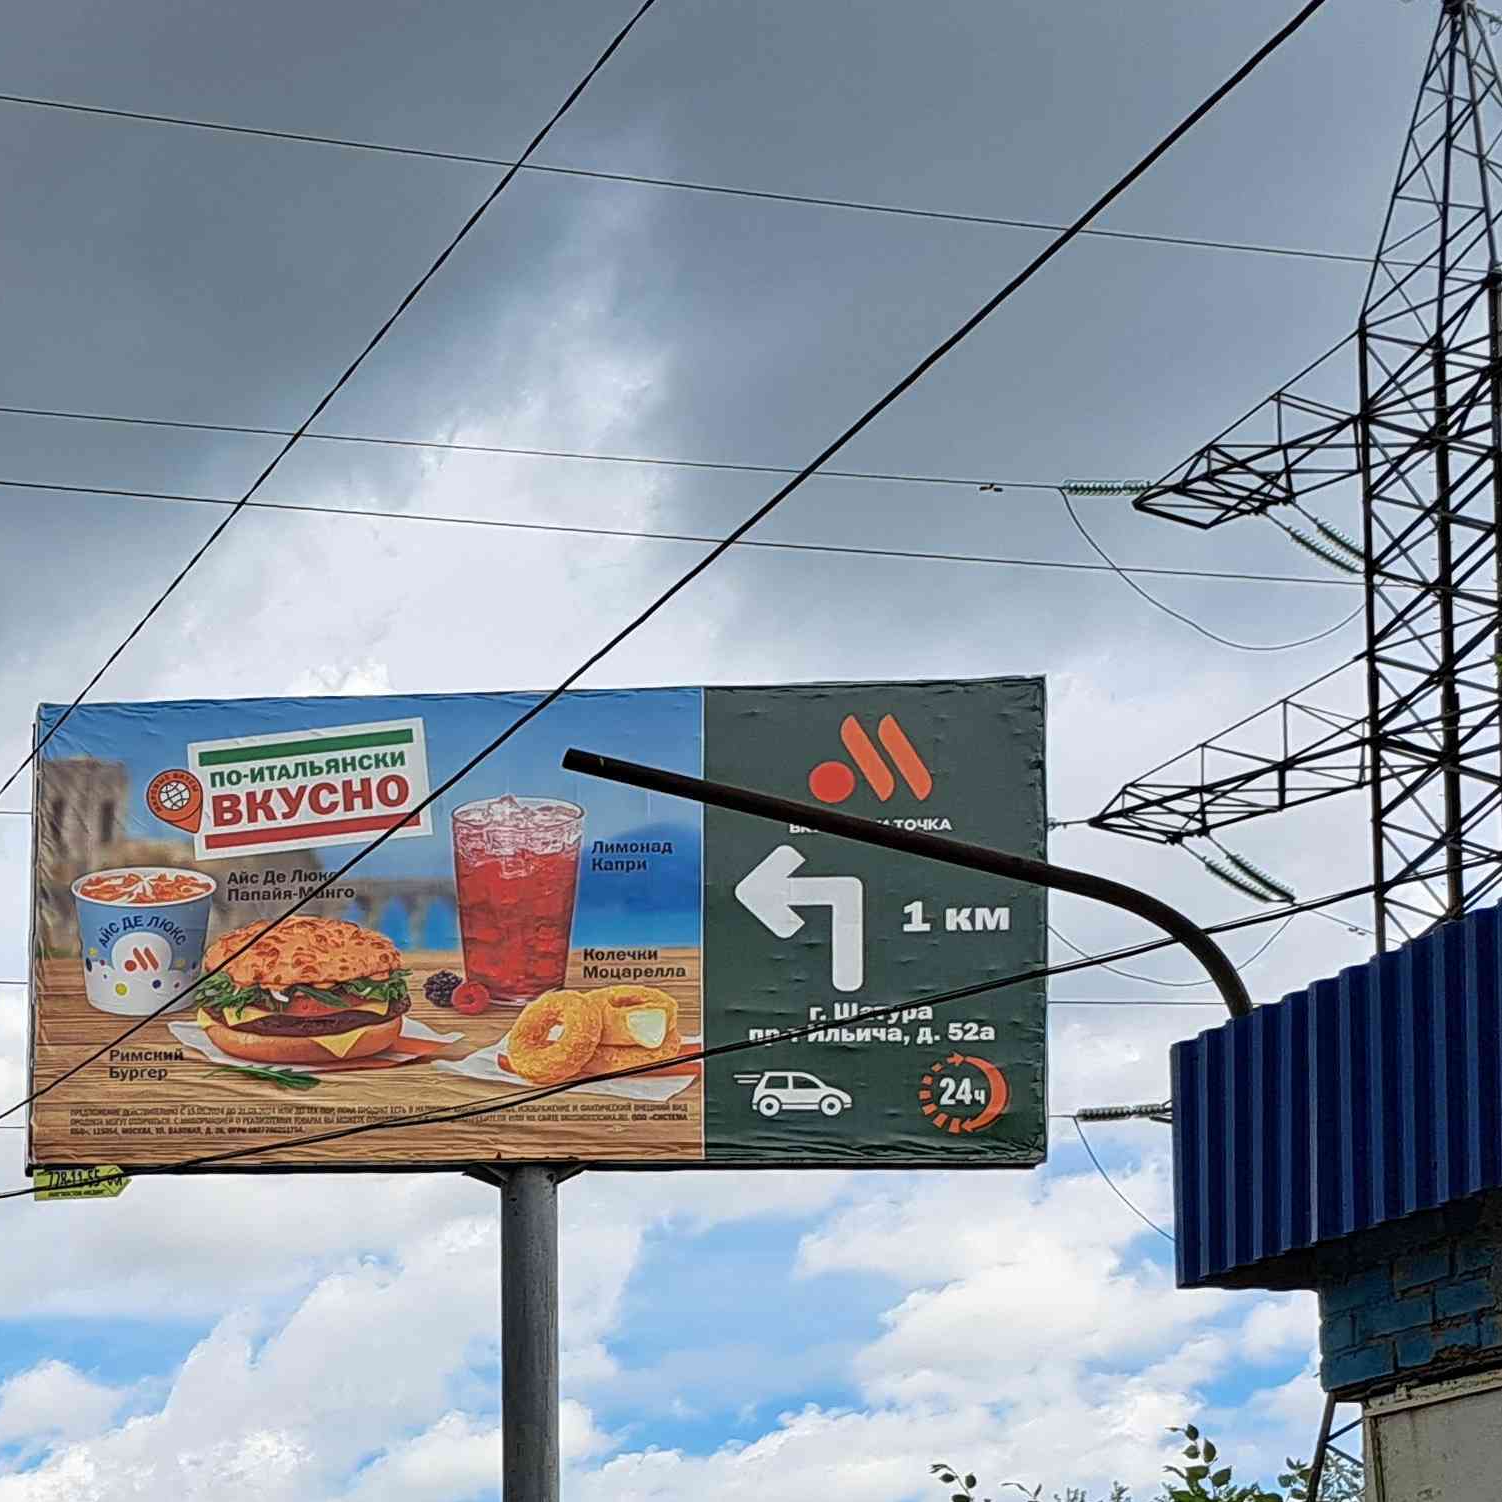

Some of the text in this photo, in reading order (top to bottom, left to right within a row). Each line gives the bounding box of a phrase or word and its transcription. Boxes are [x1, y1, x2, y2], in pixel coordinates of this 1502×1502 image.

[210, 751, 406, 788] ПО-ИТАЛЬЯНСКИ
[211, 774, 410, 827] ВКУСНО
[591, 841, 674, 855] Лимонад
[592, 858, 648, 873] Капри
[227, 871, 259, 885] Айс
[263, 870, 286, 885] Де
[228, 886, 355, 901] Папайя-Манго
[903, 900, 1010, 932] 1 км
[99, 915, 186, 948] АЙС ДЕ ЛЮКС
[583, 948, 658, 961] Колечки
[583, 965, 686, 980] Моцарелла
[810, 1007, 826, 1021] г.
[807, 1024, 910, 1045] Ильича,
[917, 1027, 941, 1045] д.
[948, 1023, 996, 1041] 52а
[109, 1049, 184, 1062] Римский
[109, 1066, 168, 1081] Бургер
